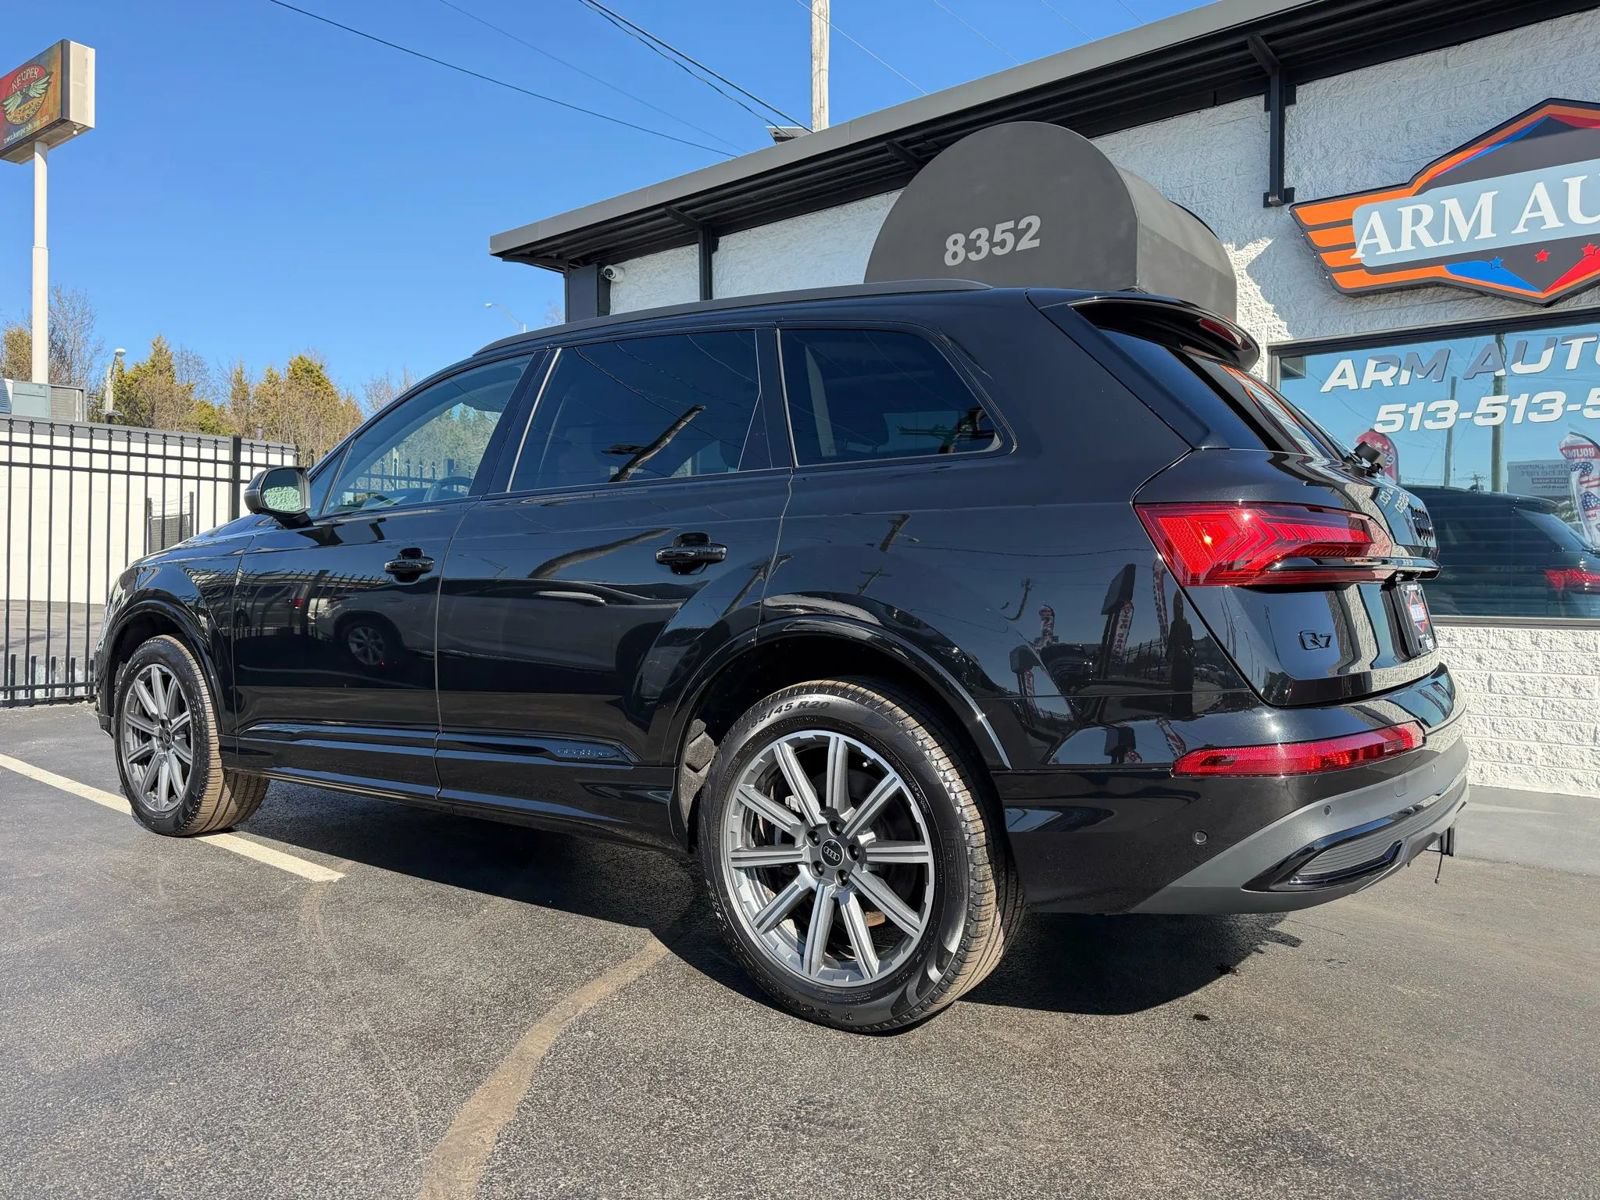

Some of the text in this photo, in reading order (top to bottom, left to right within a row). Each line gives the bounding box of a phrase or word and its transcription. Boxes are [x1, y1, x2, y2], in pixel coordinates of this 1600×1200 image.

[944, 214, 1041, 266] 8352
[1351, 191, 1498, 258] ARM
[1321, 333, 1600, 393] ARM AUT
[1299, 630, 1331, 651] Q7
[797, 700, 830, 710] R20
